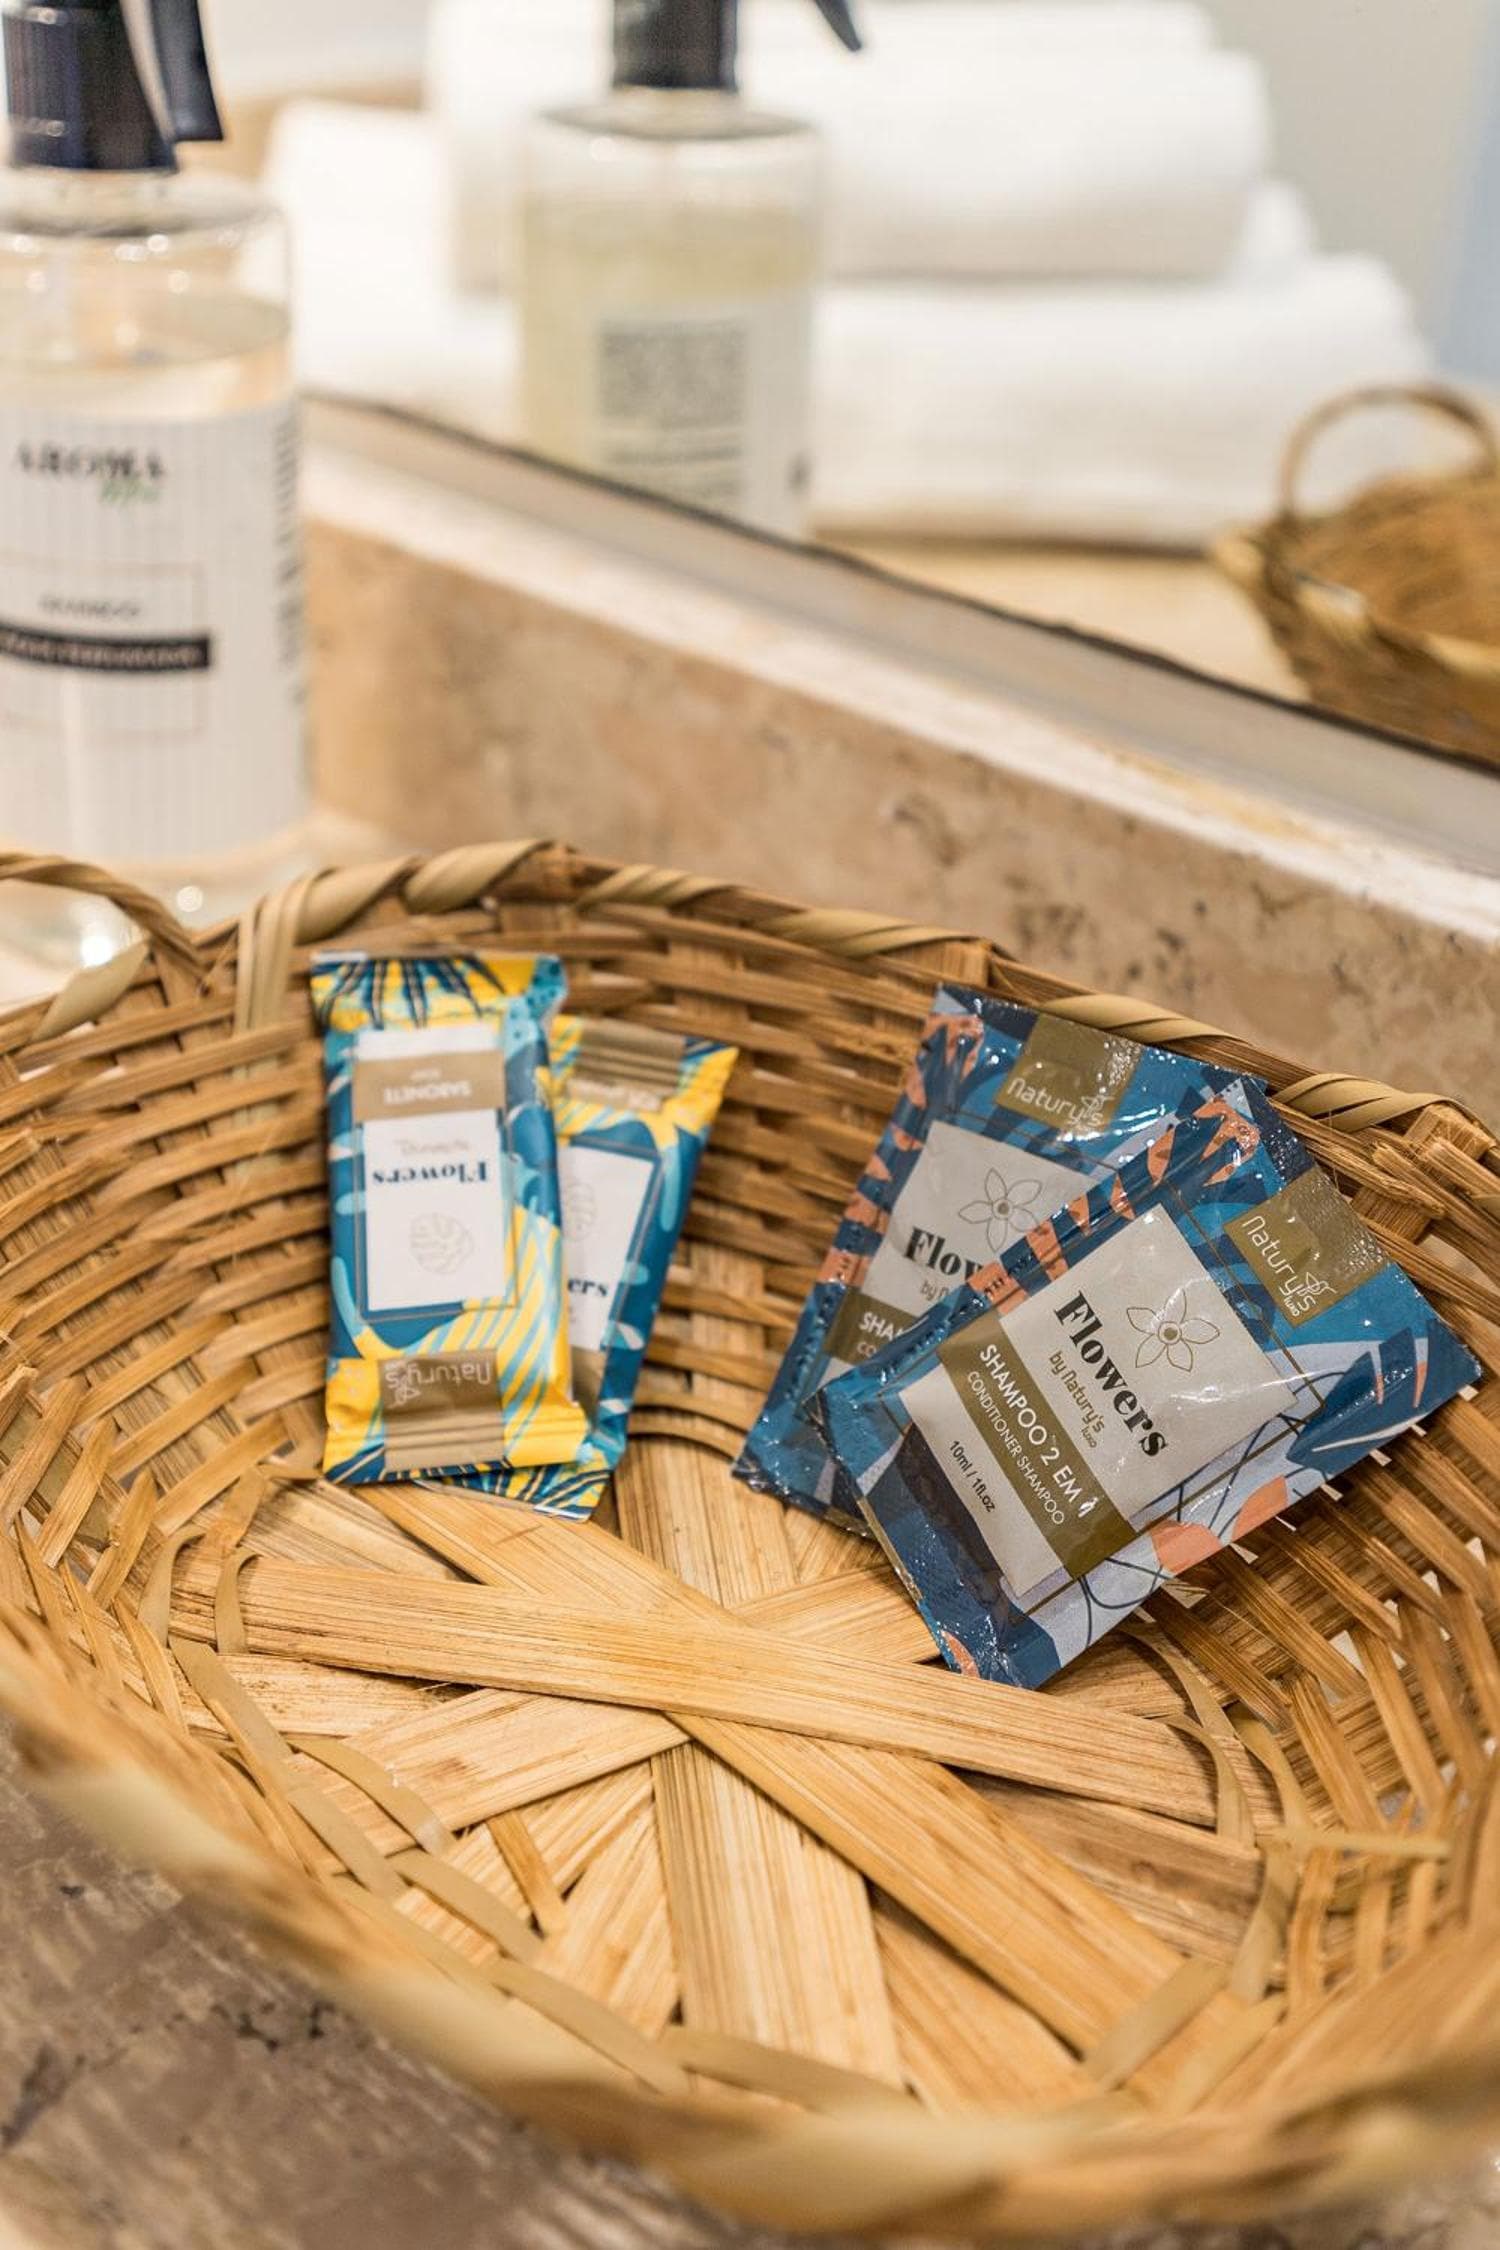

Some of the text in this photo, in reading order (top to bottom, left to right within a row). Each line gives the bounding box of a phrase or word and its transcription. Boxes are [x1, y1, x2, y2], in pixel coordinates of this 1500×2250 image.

[372, 1161, 487, 1183] Flowers
[1049, 1350, 1067, 1375] by
[1053, 1290, 1168, 1457] Flowers
[980, 1344, 1083, 1503] SHAMPOO 2 EM
[1080, 1427, 1097, 1448] luxo
[950, 1440, 972, 1473] 10ml
[967, 1371, 1065, 1525] CONDITIONER SHAMPOO
